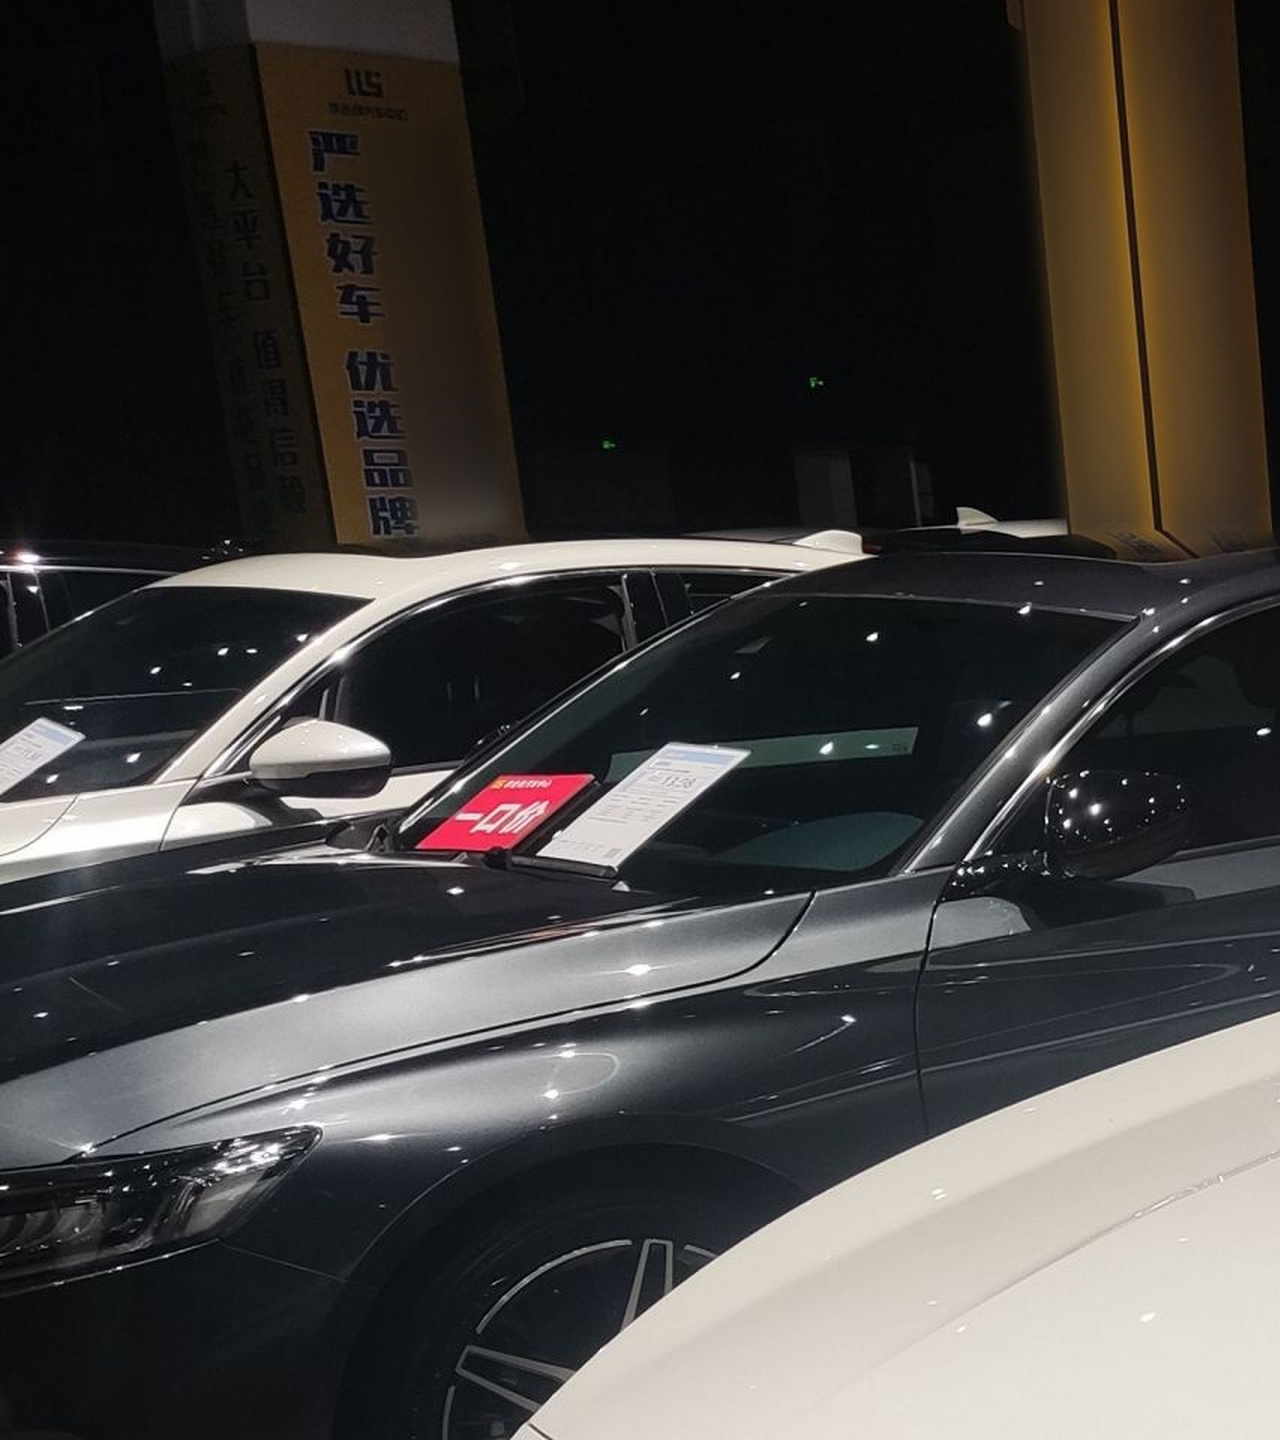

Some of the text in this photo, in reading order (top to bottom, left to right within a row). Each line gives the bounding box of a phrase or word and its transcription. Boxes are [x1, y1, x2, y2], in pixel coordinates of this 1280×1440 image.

[308, 130, 386, 325] 严选好车
[345, 350, 420, 537] 优选品牌
